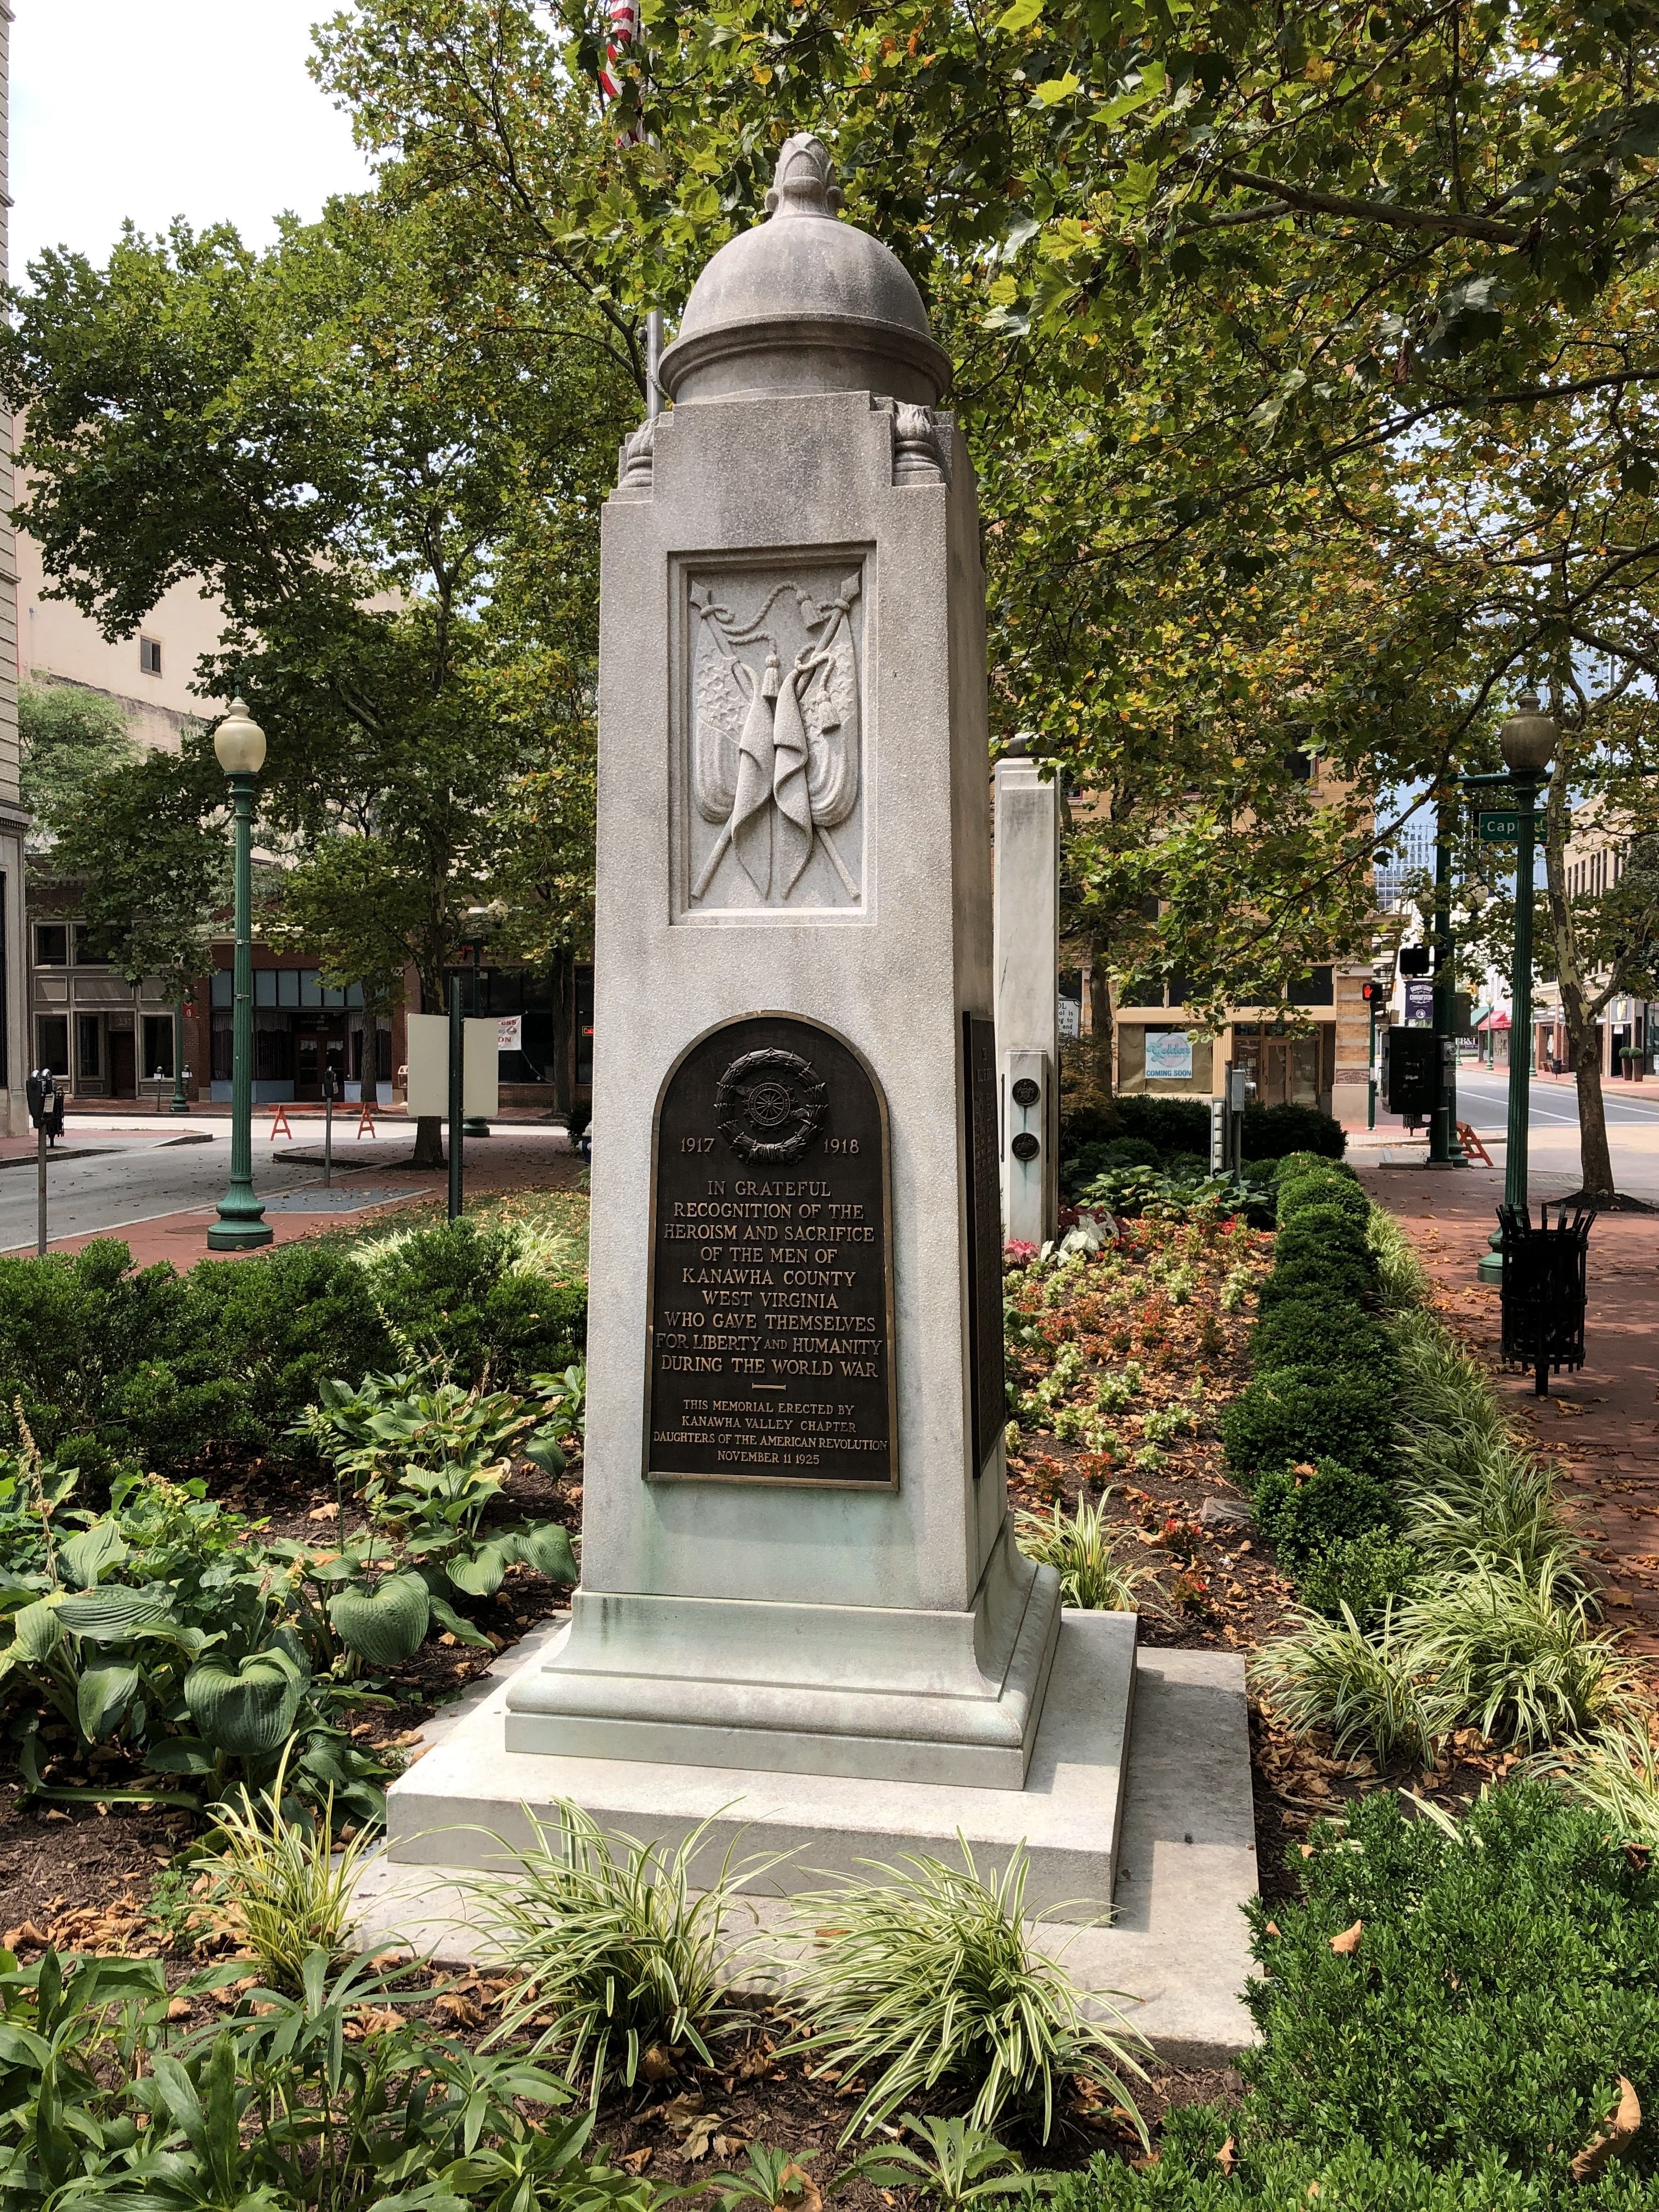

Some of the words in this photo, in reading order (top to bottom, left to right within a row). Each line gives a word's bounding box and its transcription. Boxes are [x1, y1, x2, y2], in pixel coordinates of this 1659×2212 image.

[680, 1138, 715, 1153] 1917
[823, 1138, 860, 1153] 1918
[708, 1181, 725, 1195] IN
[735, 1181, 831, 1197] GRATEFUL
[674, 1203, 792, 1218] RECOGNITION
[798, 1204, 821, 1219] OF
[828, 1204, 864, 1220] THE
[664, 1224, 737, 1240] HEROISM
[743, 1226, 779, 1242] AND
[785, 1226, 874, 1242] SACRIFICE
[701, 1246, 722, 1262] OF
[730, 1246, 764, 1262] THE
[770, 1248, 808, 1263] MEN
[814, 1249, 837, 1264] OF
[682, 1268, 774, 1285] KANAWHA
[783, 1270, 856, 1286] COUNTY
[702, 1290, 753, 1307] WEST
[760, 1292, 839, 1309] VIRGINIA
[664, 1311, 705, 1328] WHO
[713, 1313, 757, 1329] GAVE
[765, 1314, 876, 1332] THEMSELVES
[656, 1333, 689, 1349] FOR
[693, 1334, 763, 1352] LIBERTY
[764, 1339, 788, 1350] AND
[792, 1338, 883, 1356] HUMANITY
[662, 1355, 723, 1372] DURING
[731, 1358, 765, 1374] THE
[771, 1359, 833, 1375] WORLD
[840, 1361, 878, 1378] WAR
[684, 1400, 708, 1410] THIS
[713, 1400, 774, 1413] MEMORIAL
[778, 1403, 833, 1414] ERECTED
[838, 1404, 855, 1415] BY
[682, 1416, 741, 1428] KANAWHA
[745, 1418, 794, 1430] VALLEY
[800, 1420, 857, 1432] CHAPTER
[653, 1431, 715, 1443] DAUGHTERS
[718, 1434, 732, 1444] OF
[735, 1434, 757, 1445] THE
[759, 1436, 816, 1448] AMERICAN
[819, 1438, 887, 1451] REVOLUTION
[718, 1451, 780, 1463] NOVEMBER
[783, 1453, 792, 1464] 11
[795, 1454, 820, 1465] 1925
